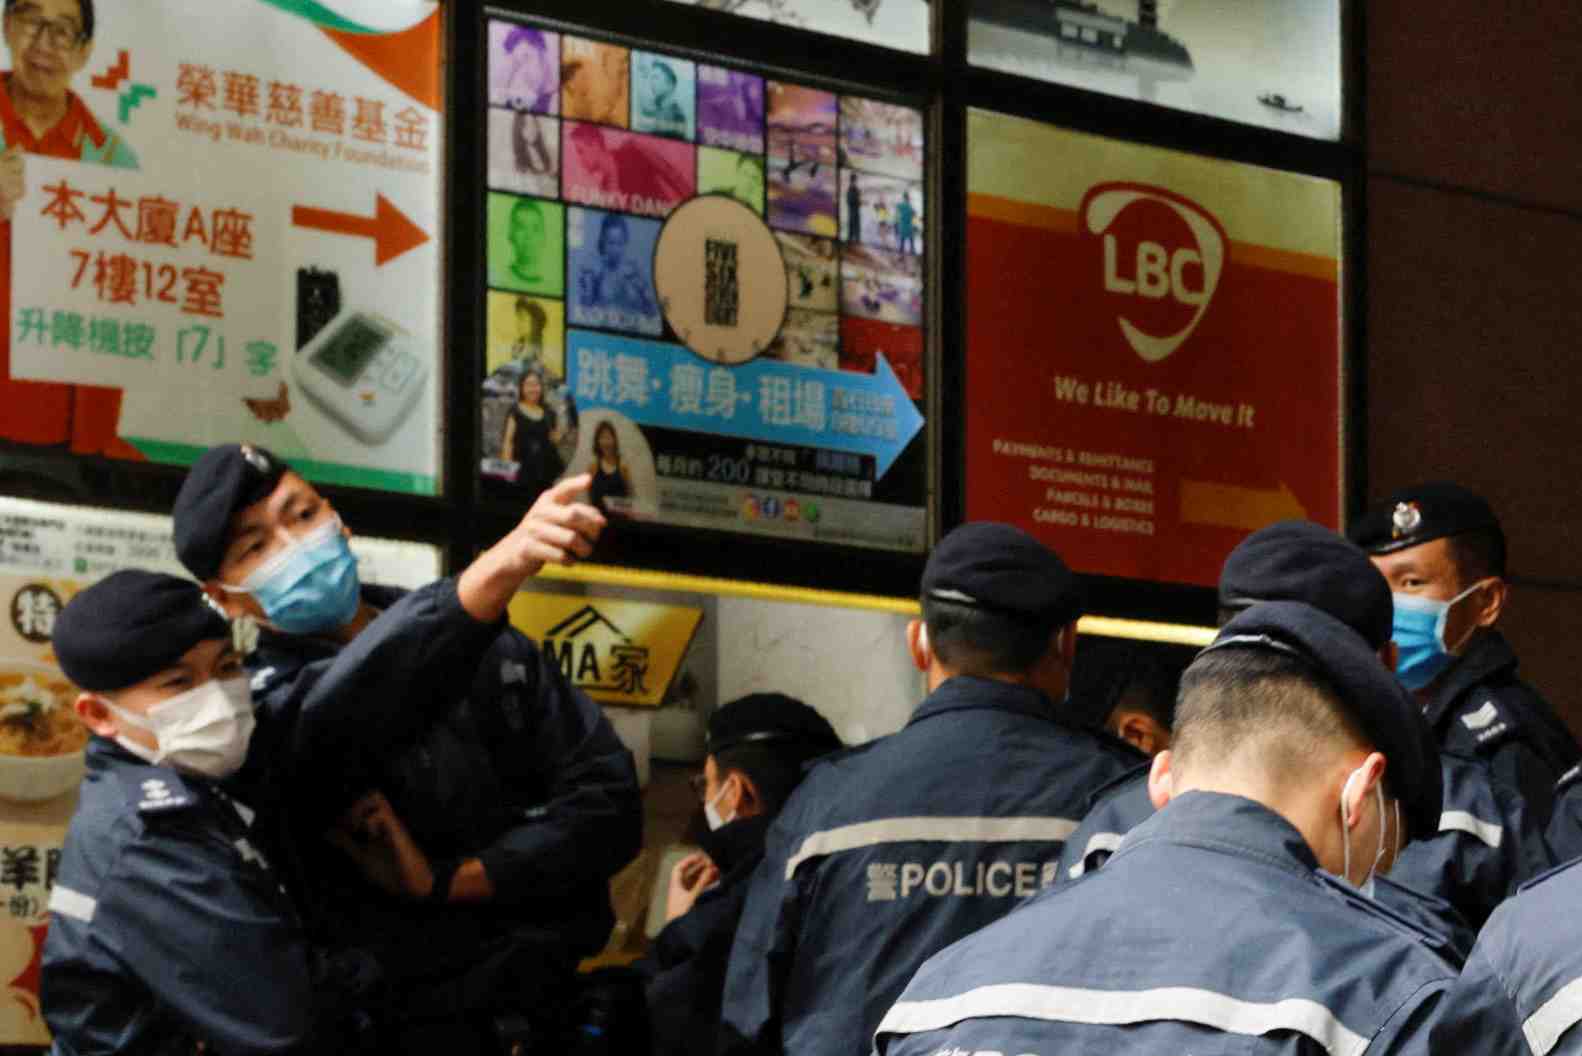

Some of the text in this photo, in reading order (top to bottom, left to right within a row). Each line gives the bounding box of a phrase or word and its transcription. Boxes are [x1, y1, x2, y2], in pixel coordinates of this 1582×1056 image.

[269, 128, 329, 160] Charity
[40, 179, 255, 261] 本大廈A座
[69, 249, 225, 319] 7樓12室
[1103, 234, 1207, 305] LBC
[1054, 376, 1255, 428] We Like To Move It
[706, 455, 749, 481] 200
